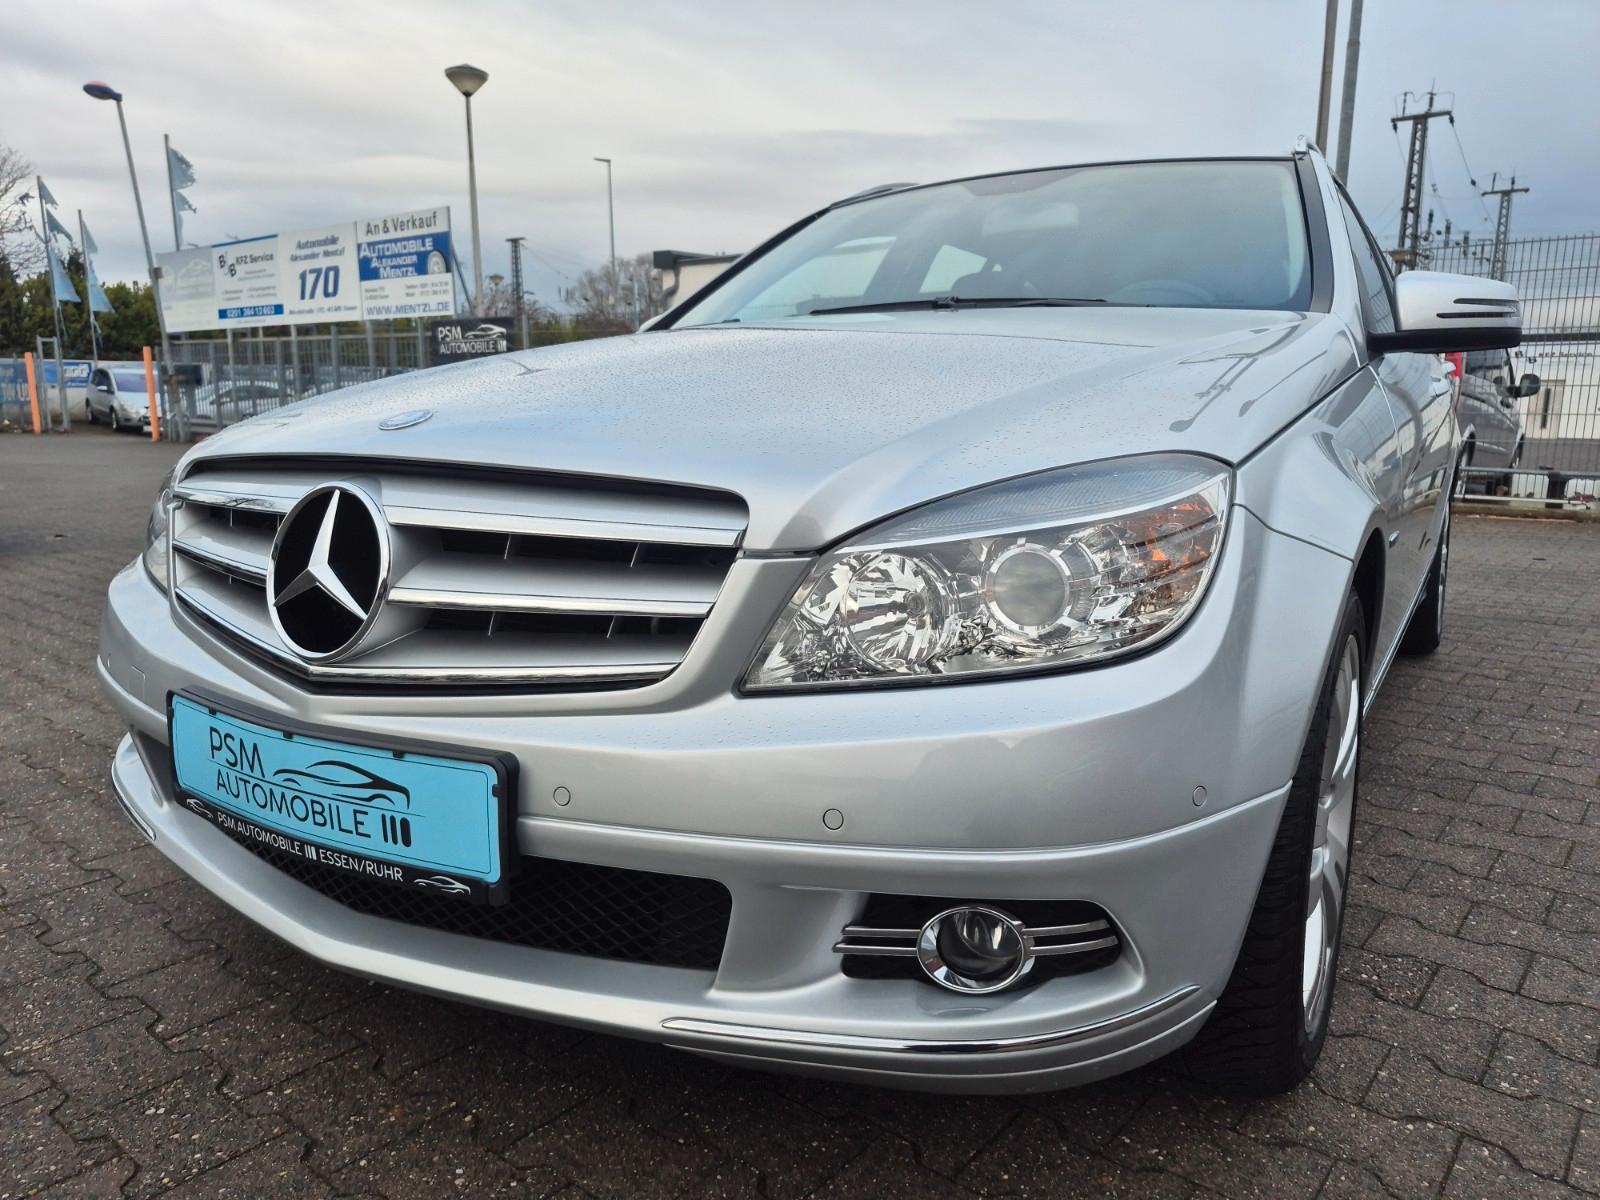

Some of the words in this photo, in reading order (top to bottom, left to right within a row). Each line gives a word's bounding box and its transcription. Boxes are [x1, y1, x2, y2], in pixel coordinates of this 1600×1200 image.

[366, 222, 380, 236] An
[383, 219, 390, 234] &
[392, 211, 437, 233] Verkauf
[249, 253, 274, 264] Service
[360, 238, 433, 259] AUTOMOBILE
[299, 265, 340, 301] 170
[366, 302, 450, 315] WWW.MENTZL.DE
[438, 326, 462, 341] PSM
[440, 341, 496, 354] AUTOMOBILE
[210, 726, 265, 778] PSM
[217, 768, 371, 838] AUTOMOBILE
[217, 812, 236, 831] PSM
[238, 822, 302, 855] AUTOMOBILE
[319, 848, 404, 882] ESSEN/RUHR
